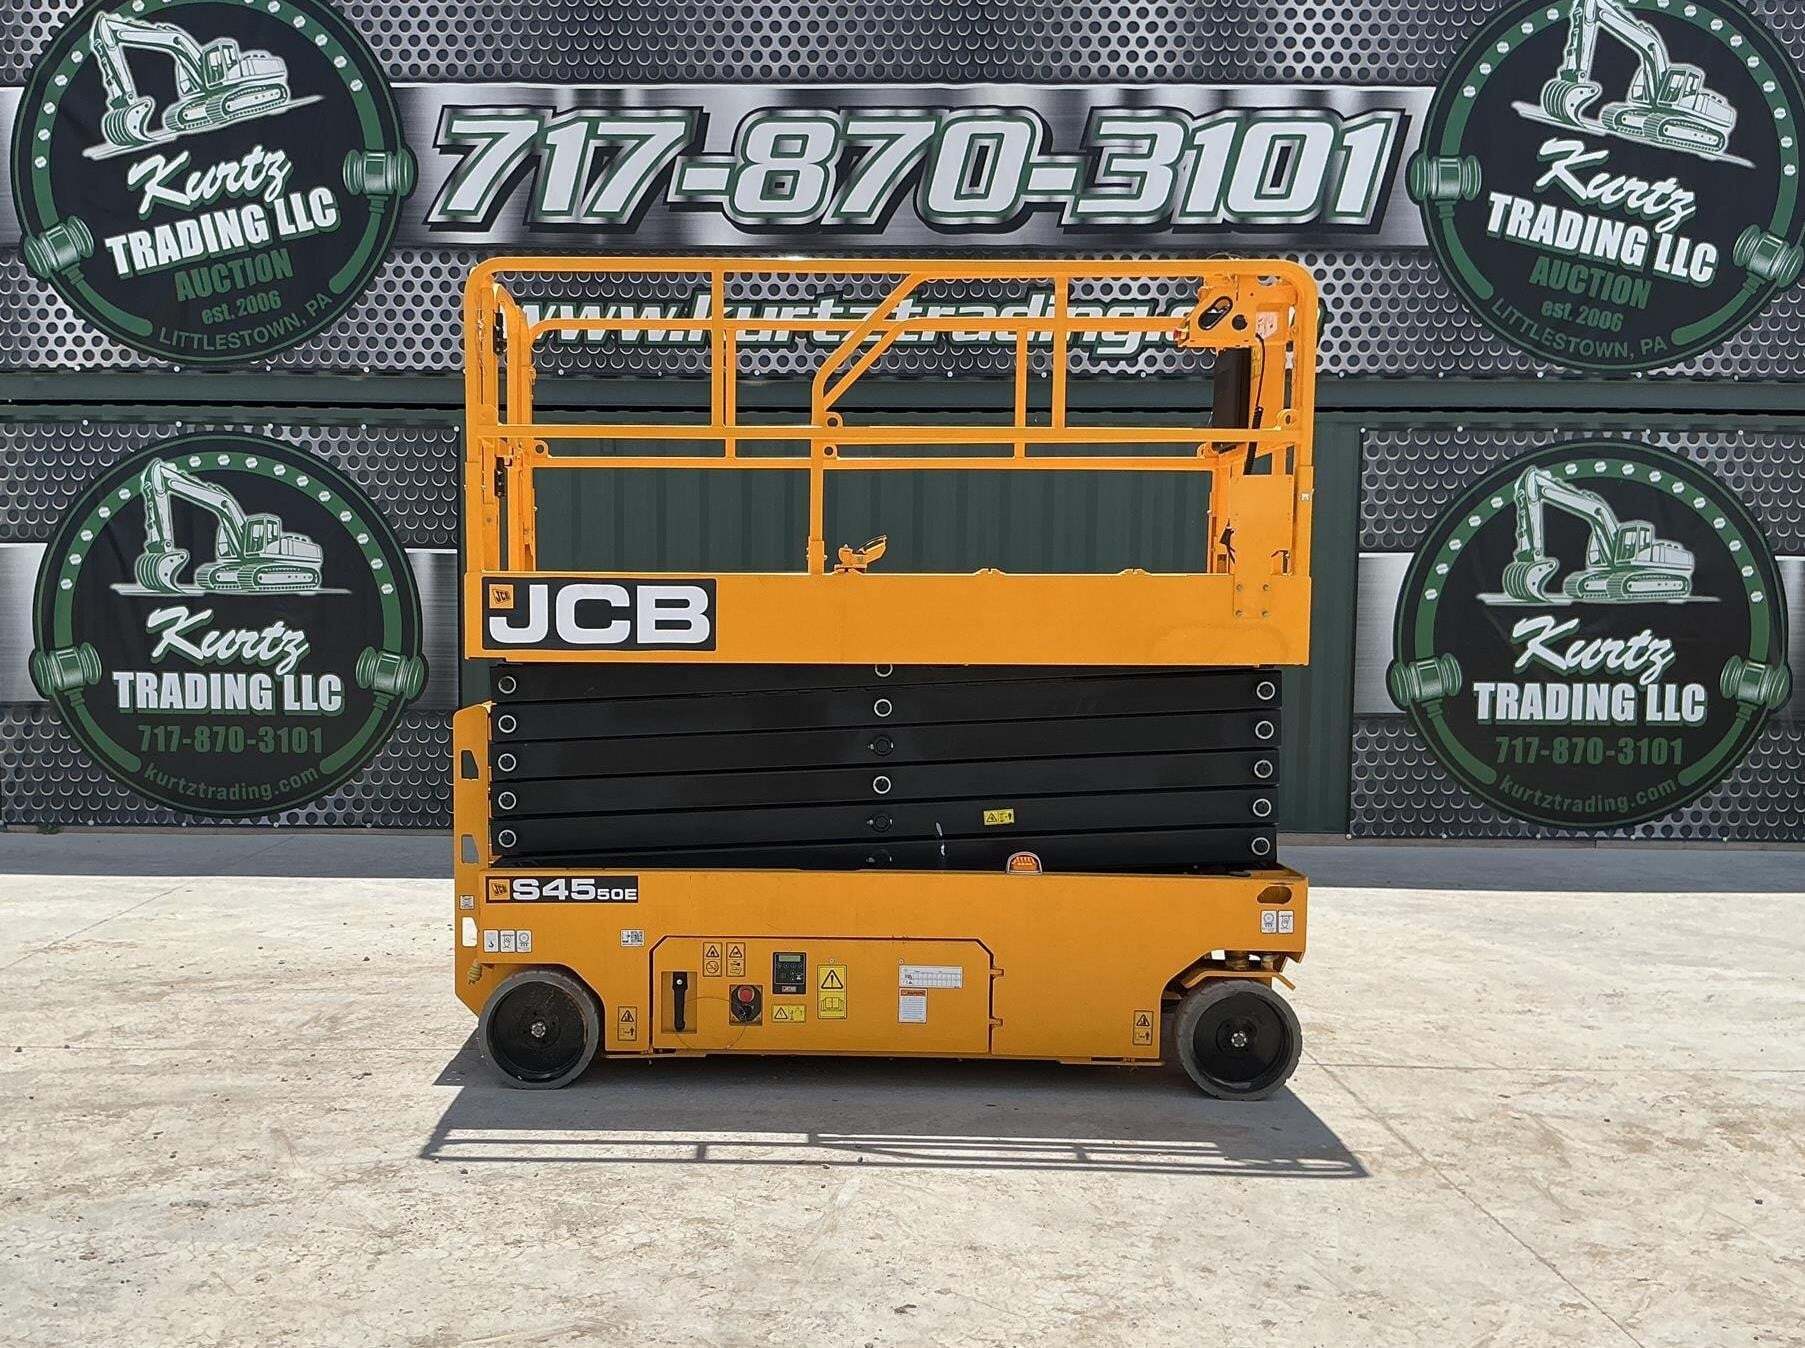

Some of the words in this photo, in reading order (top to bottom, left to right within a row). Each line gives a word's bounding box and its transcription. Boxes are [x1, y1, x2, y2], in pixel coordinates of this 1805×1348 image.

[127, 145, 293, 217] Kurtz
[430, 108, 1402, 225] 717-870-3101
[1536, 137, 1697, 234] Kurtz
[105, 204, 270, 277] TRADING
[273, 187, 339, 237] LLC
[1487, 192, 1650, 270] TRADING
[1653, 232, 1718, 286] LLC
[174, 249, 293, 302] AUCTION
[1529, 256, 1653, 310] AUCTION
[159, 312, 304, 350] LITTLESTOWN,
[305, 293, 333, 319] PA
[201, 308, 233, 326] est.
[236, 292, 282, 318] 2006
[1491, 300, 1635, 360] LITTLESTOWN,
[1640, 336, 1668, 355] PA
[1576, 305, 1624, 332] 2006
[489, 583, 710, 643] JCB
[146, 606, 310, 676] Kurtz
[1511, 615, 1676, 685] Kurtz
[112, 671, 275, 713] TRADING
[282, 674, 345, 716] LLC
[1473, 683, 1637, 724] TRADING
[1646, 683, 1708, 727] LLC
[138, 725, 323, 753] 717-870-3101
[1495, 736, 1683, 765] 717-870-3101
[145, 763, 318, 801] kurtztrading.com
[1499, 774, 1678, 813] kurtztrading.com
